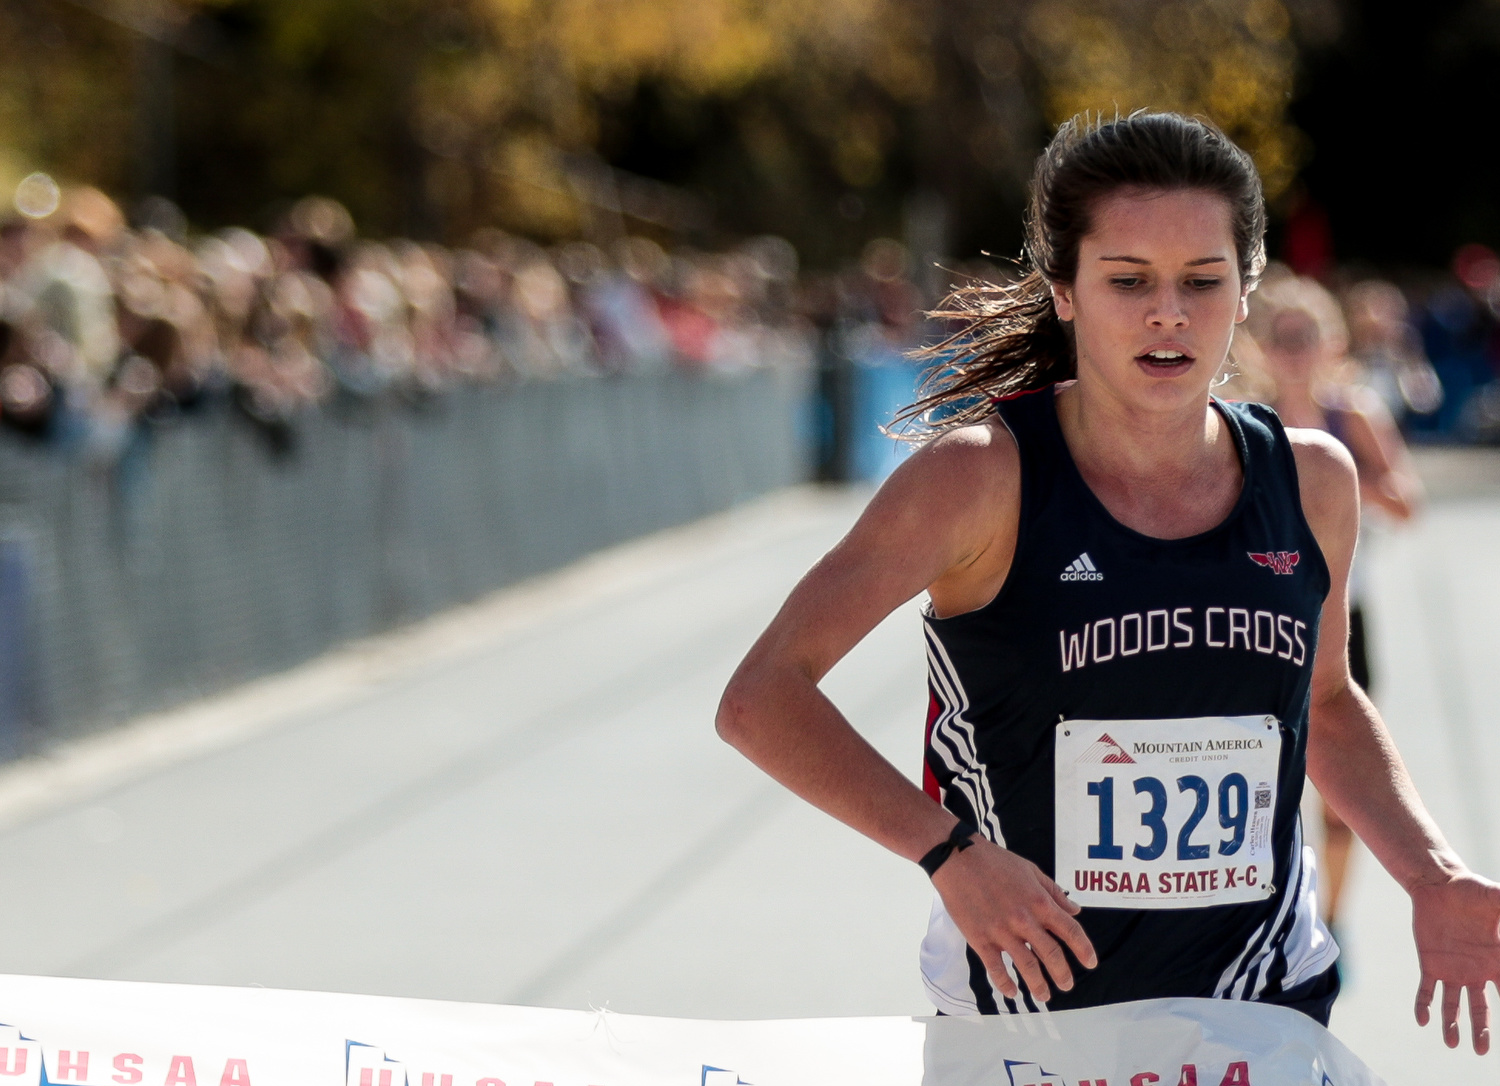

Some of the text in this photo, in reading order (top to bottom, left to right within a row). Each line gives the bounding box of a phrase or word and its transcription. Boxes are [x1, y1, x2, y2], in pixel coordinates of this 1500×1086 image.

[1060, 570, 1104, 582] adidas
[1059, 606, 1307, 673] WOODS CROSS
[1133, 738, 1264, 755] MOUNTAIN AMERICA
[1168, 753, 1229, 764] CREDIT UNION
[1086, 771, 1249, 861] 1329
[1074, 864, 1258, 894] UHSAA STATE X-C
